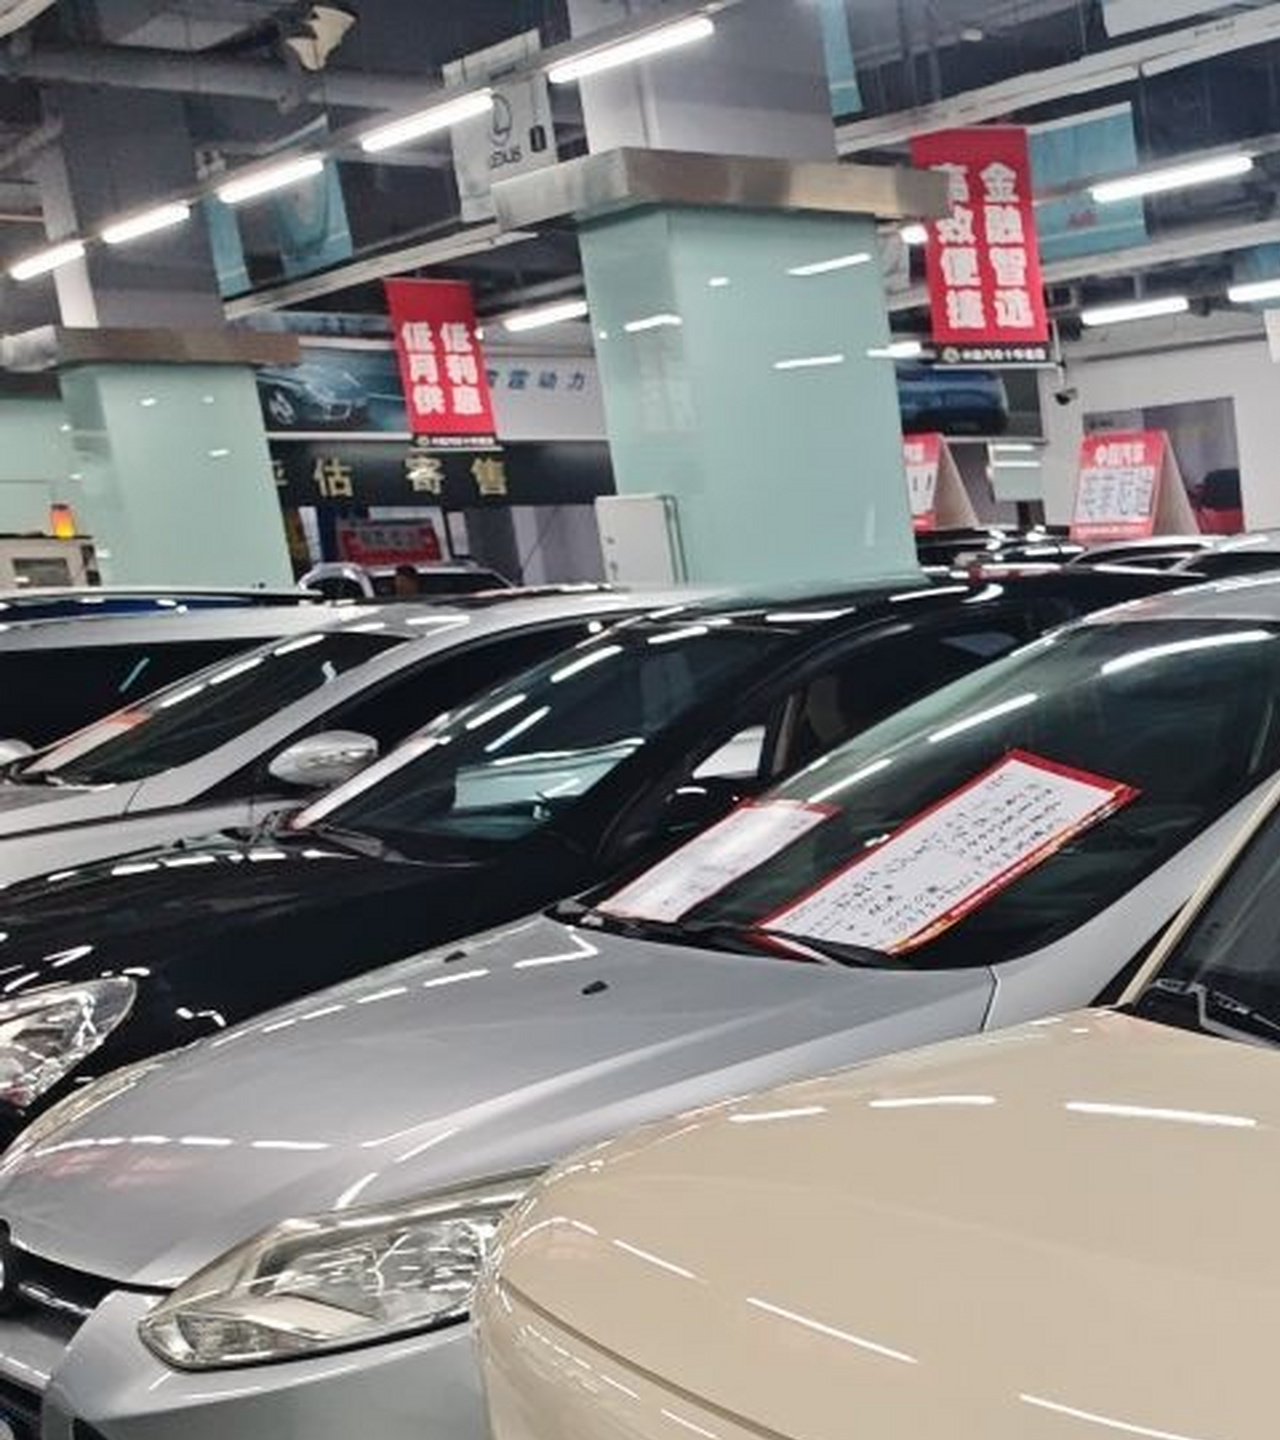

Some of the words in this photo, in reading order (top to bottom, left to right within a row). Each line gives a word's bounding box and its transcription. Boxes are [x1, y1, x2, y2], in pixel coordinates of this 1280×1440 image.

[402, 322, 446, 415] 低月供
[440, 322, 483, 414] 低利息
